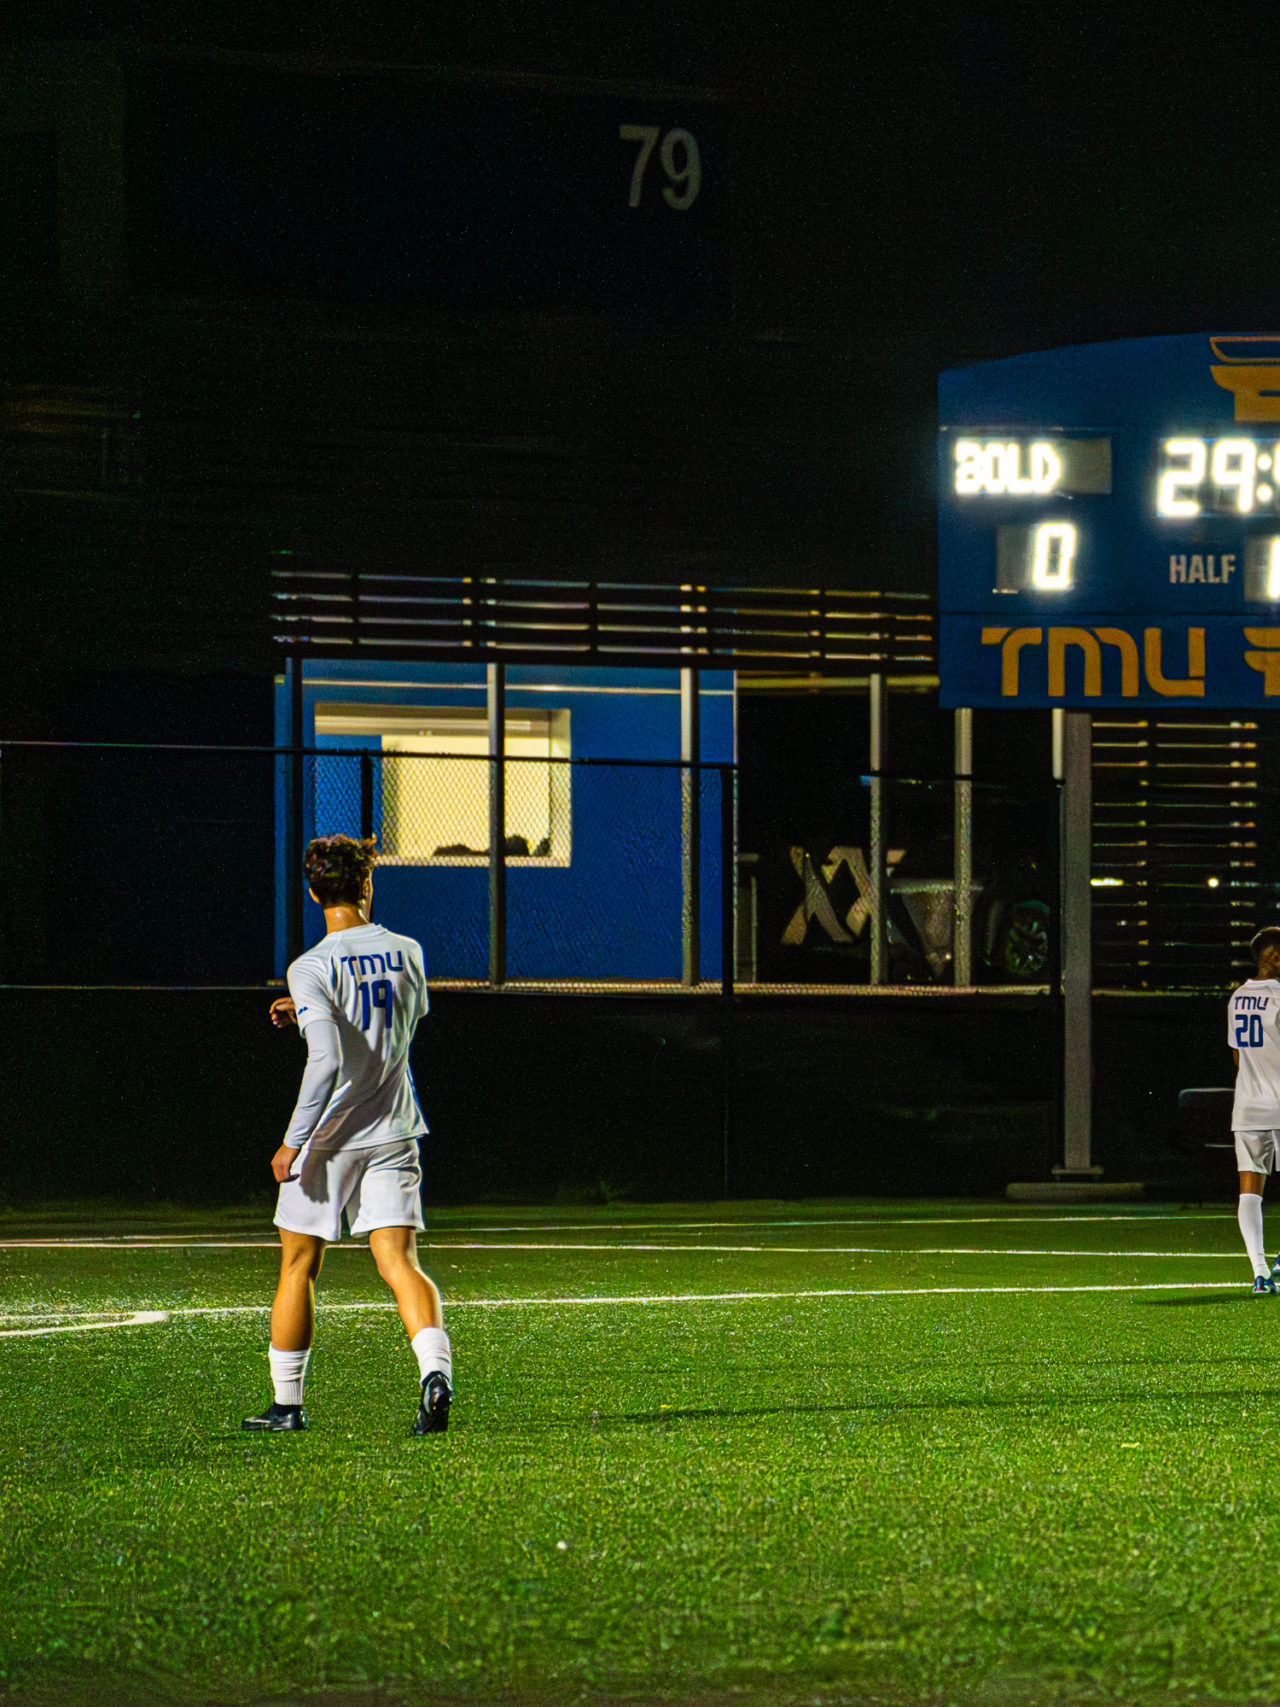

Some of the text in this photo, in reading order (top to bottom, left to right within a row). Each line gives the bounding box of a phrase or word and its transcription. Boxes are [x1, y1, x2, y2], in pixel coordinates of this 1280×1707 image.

[619, 124, 701, 210] 79
[954, 438, 1063, 497] BOLD
[1031, 521, 1077, 592] 0
[1168, 555, 1236, 584] HALF
[981, 626, 1206, 698] TMU
[341, 950, 404, 976] TMU
[358, 978, 393, 1032] 19
[1234, 996, 1269, 1011] TMU
[1235, 1013, 1264, 1048] 20
